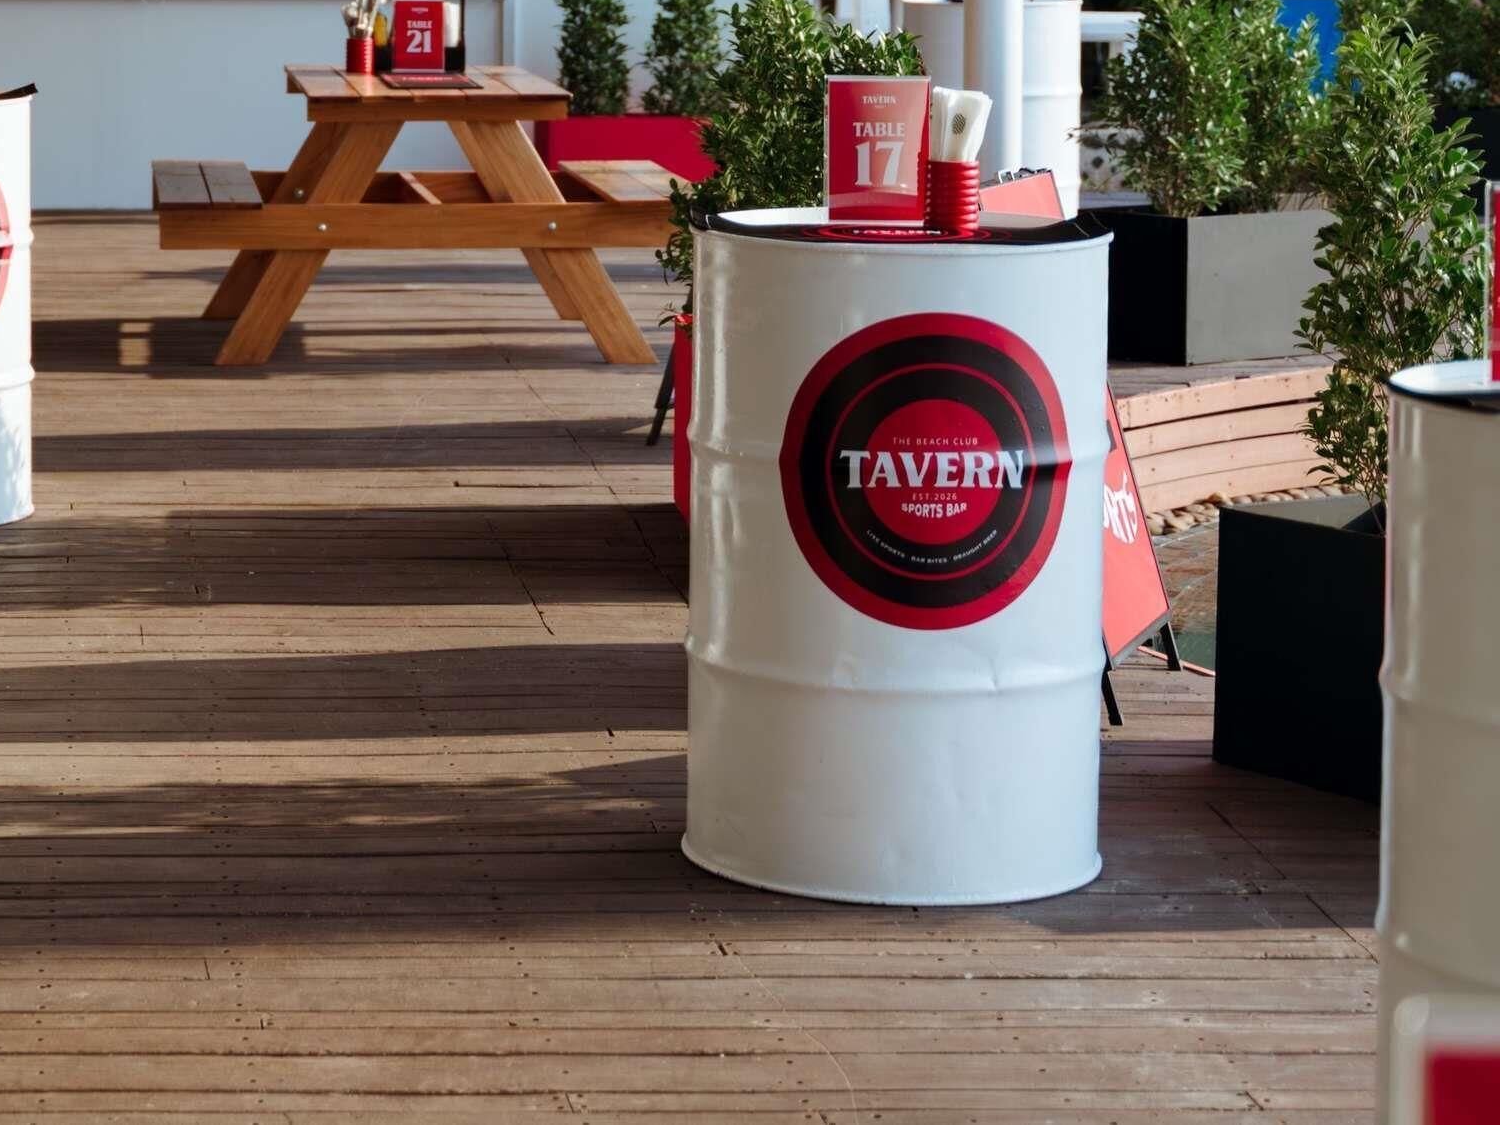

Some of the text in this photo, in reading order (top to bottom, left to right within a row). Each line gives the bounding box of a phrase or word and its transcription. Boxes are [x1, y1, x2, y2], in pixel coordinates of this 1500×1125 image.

[406, 20, 433, 29] TABLE
[406, 29, 433, 53] 21
[862, 95, 897, 105] TAVERN
[852, 122, 906, 138] TABLE
[854, 140, 905, 188] 17
[893, 436, 979, 446] THE BEACH CLUB
[839, 449, 1025, 489] TAVERN
[901, 501, 968, 519] SPORTS BAR
